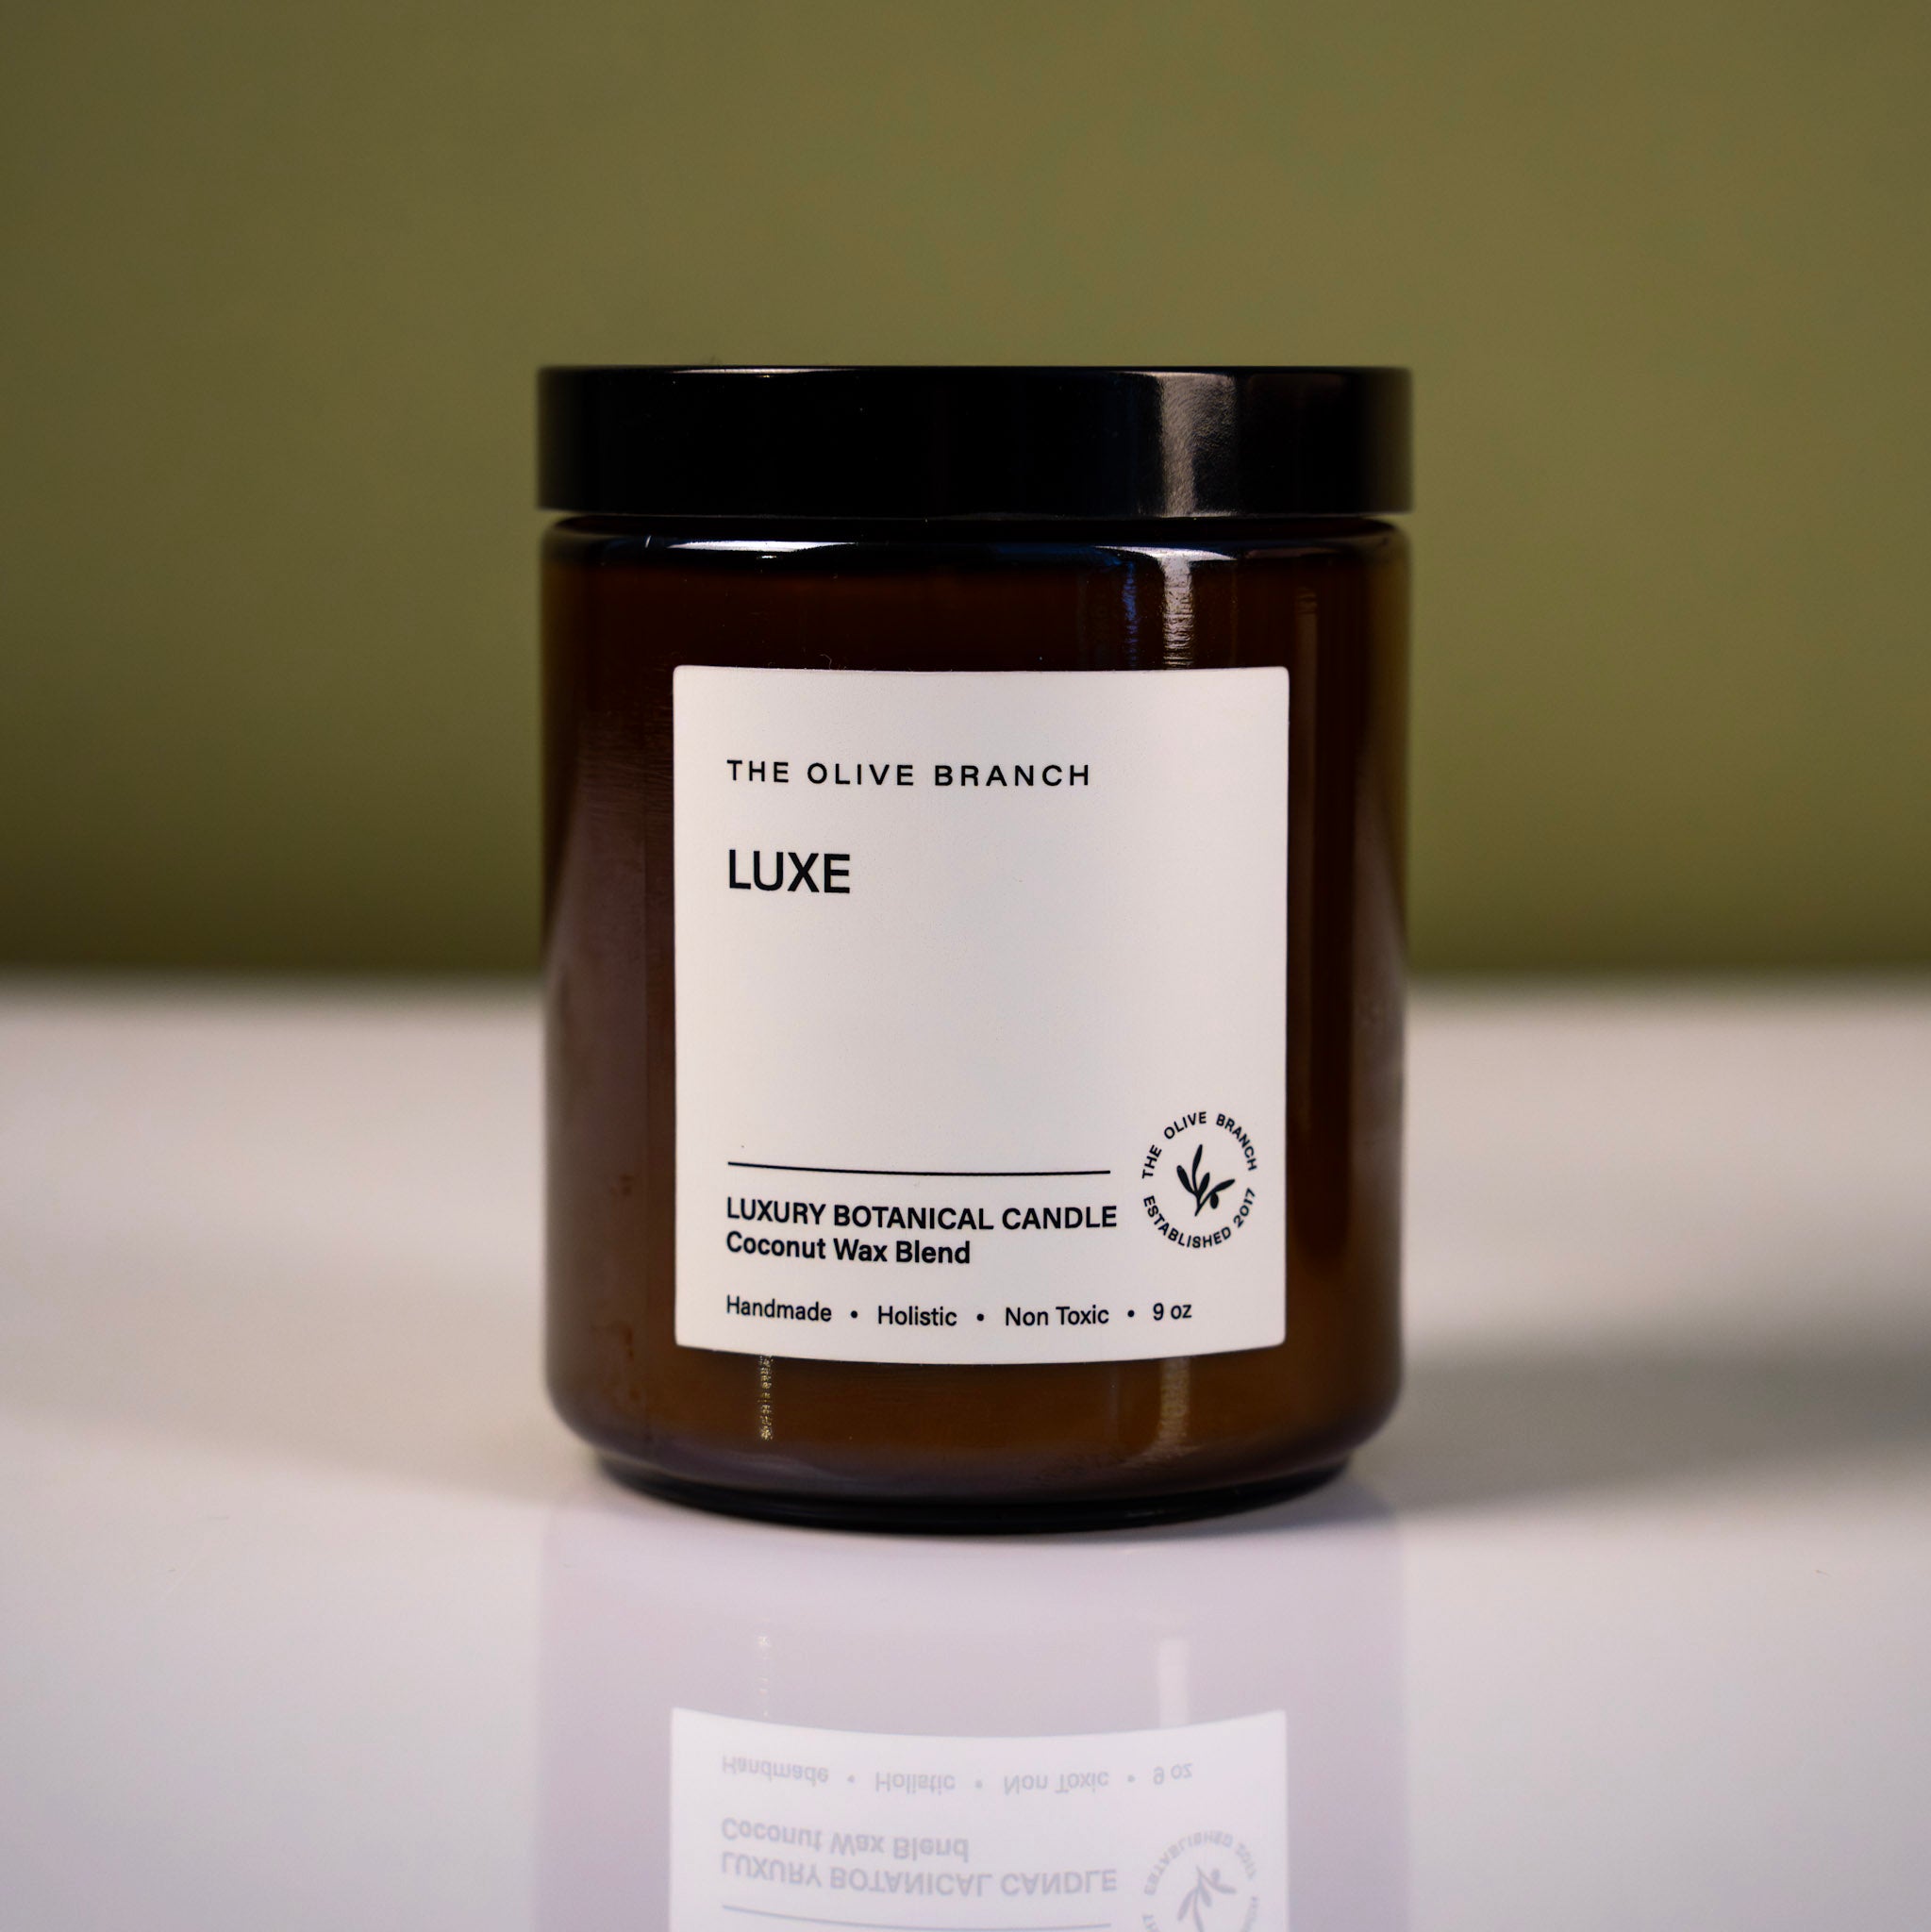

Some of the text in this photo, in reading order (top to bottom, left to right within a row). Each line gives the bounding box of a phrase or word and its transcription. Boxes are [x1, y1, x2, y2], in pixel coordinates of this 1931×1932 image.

[726, 758, 1090, 787] THE OLIVE BRANCH
[728, 848, 851, 894] LUXE
[1141, 1111, 1257, 1179] THE OLIVE BRANCH
[726, 1196, 1118, 1231] LUXURY BOTANICAL CANDLE
[1142, 1188, 1256, 1249] ESTABLISHED 2017
[725, 1230, 971, 1265] Coconut Wax Blend
[726, 1294, 1192, 1327] Handmade Holistic Non Toxic 9 oz
